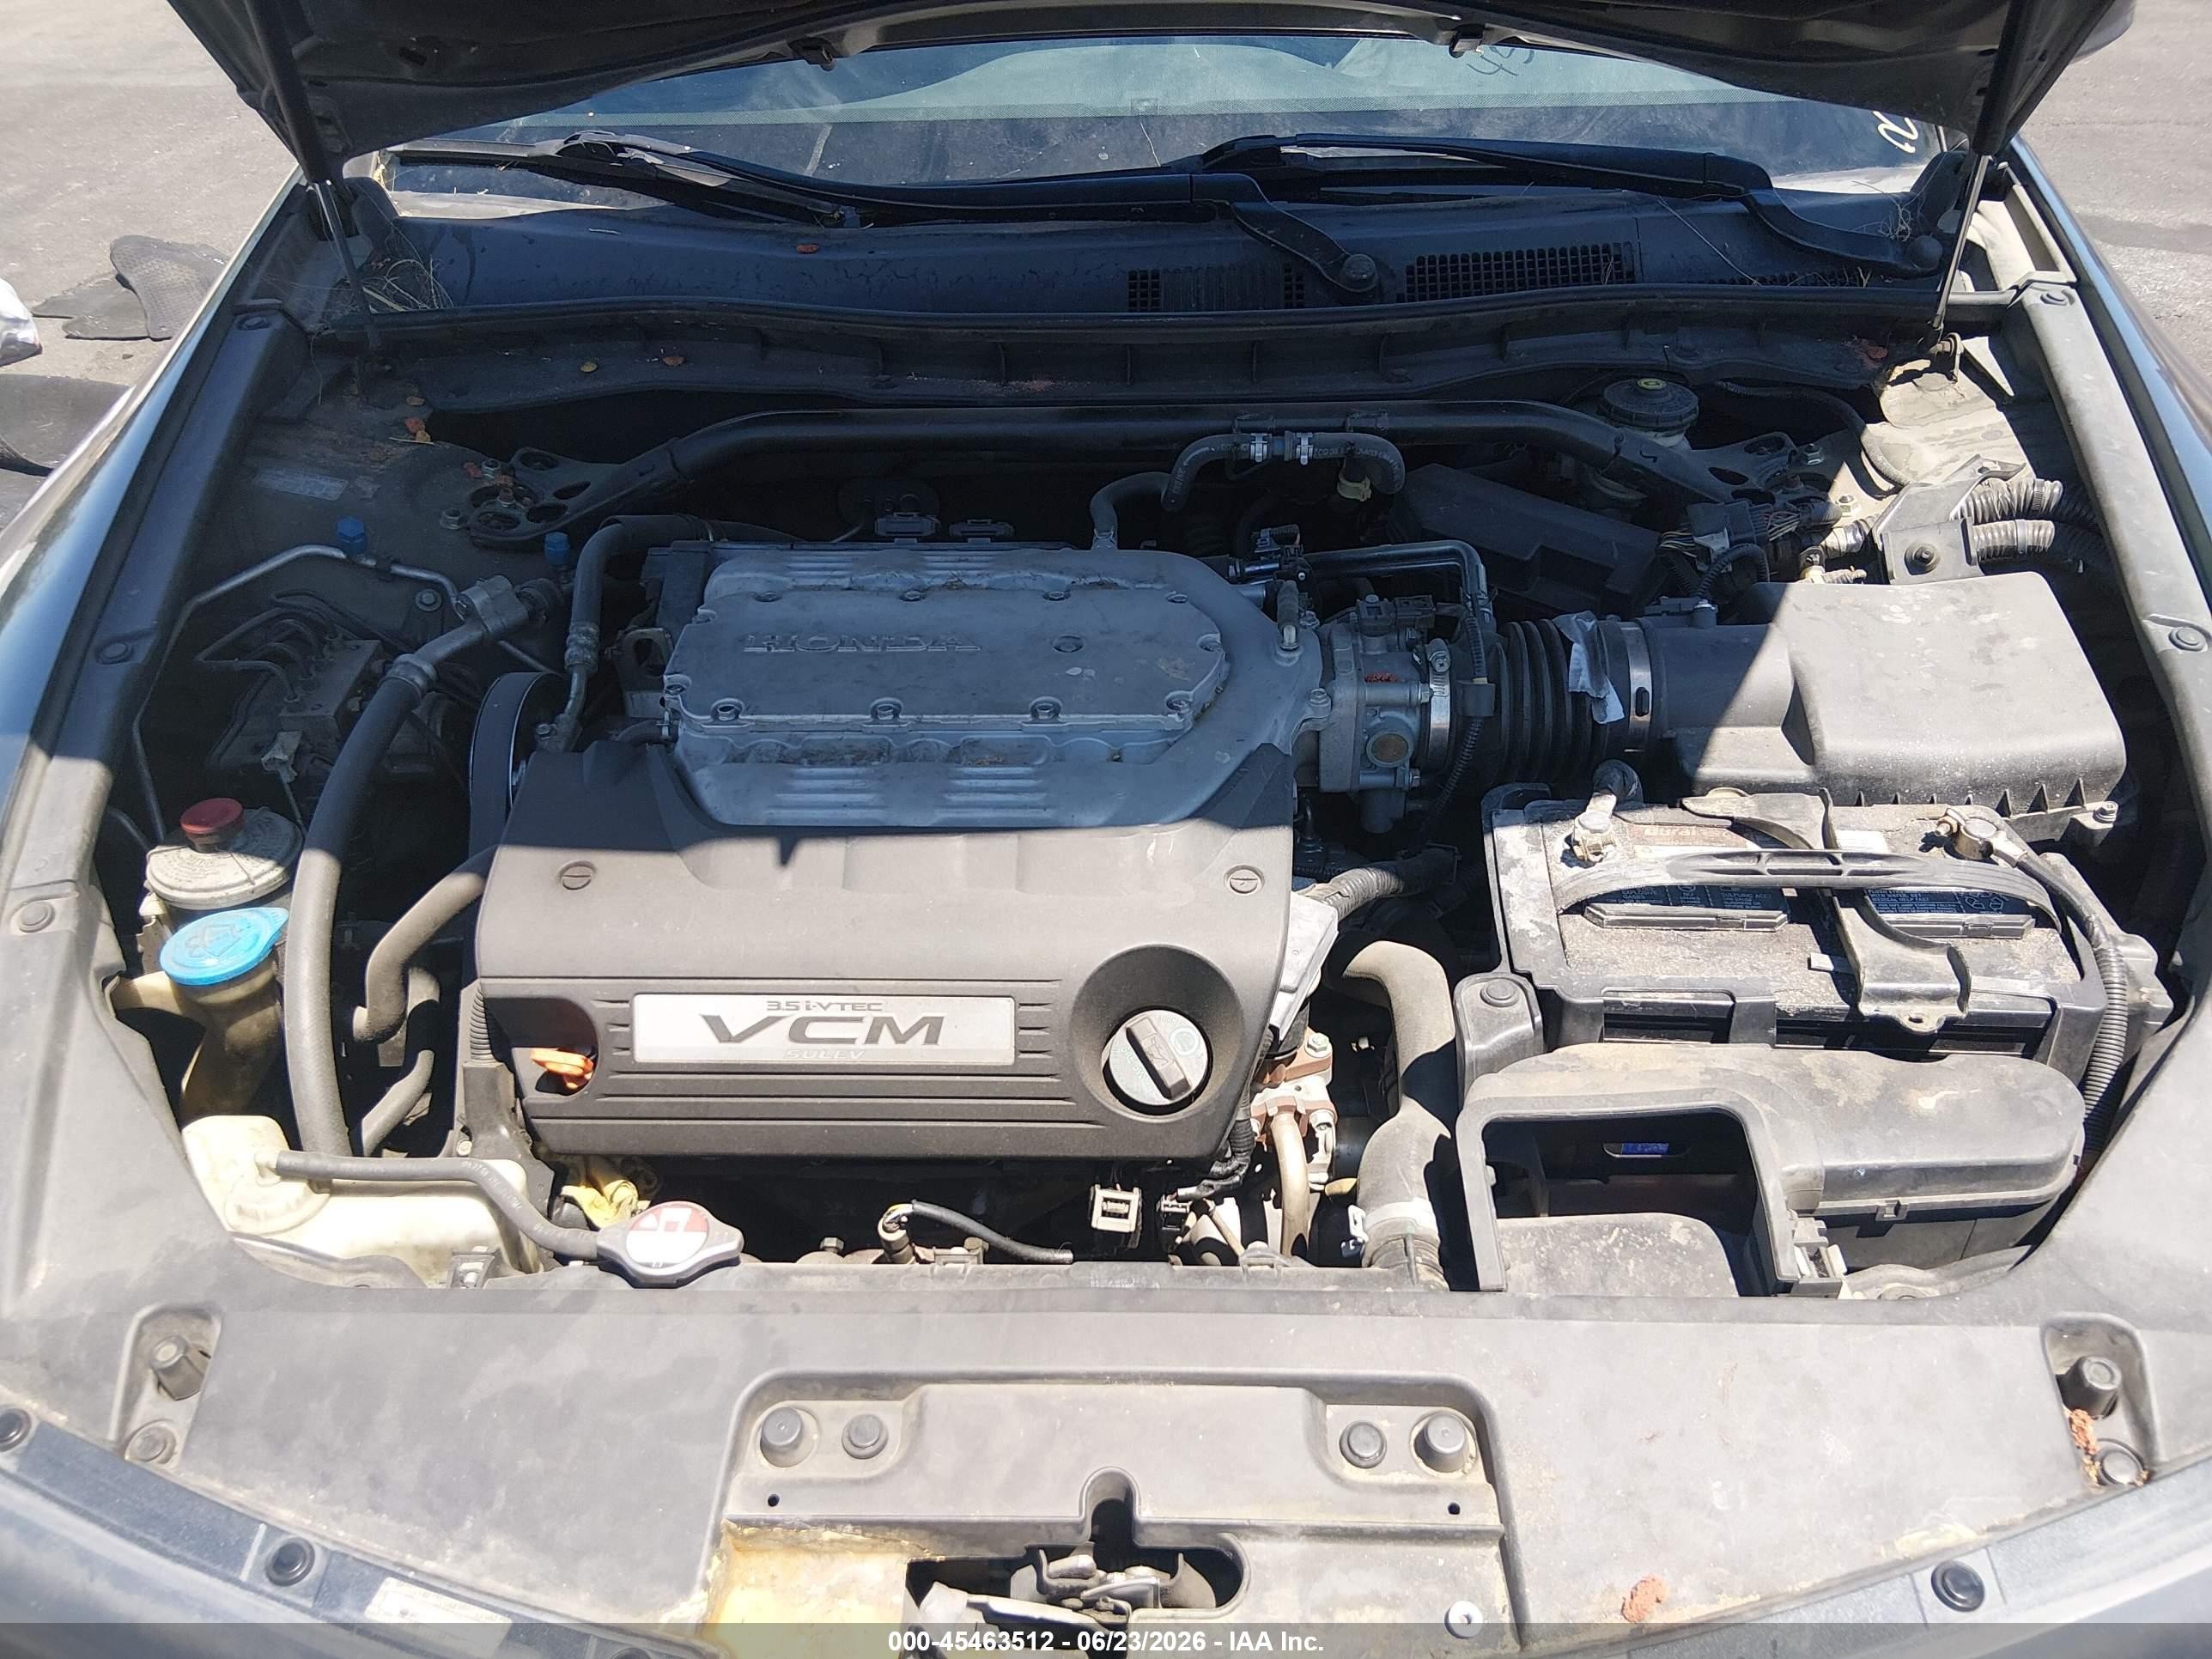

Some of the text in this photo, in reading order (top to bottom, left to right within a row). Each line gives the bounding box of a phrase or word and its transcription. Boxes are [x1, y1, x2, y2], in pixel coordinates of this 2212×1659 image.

[744, 634, 981, 653] HONDA
[766, 1000, 884, 1012] 3.5 i-VTEC
[699, 1014, 945, 1046] VCM
[783, 1048, 866, 1060] SULEV
